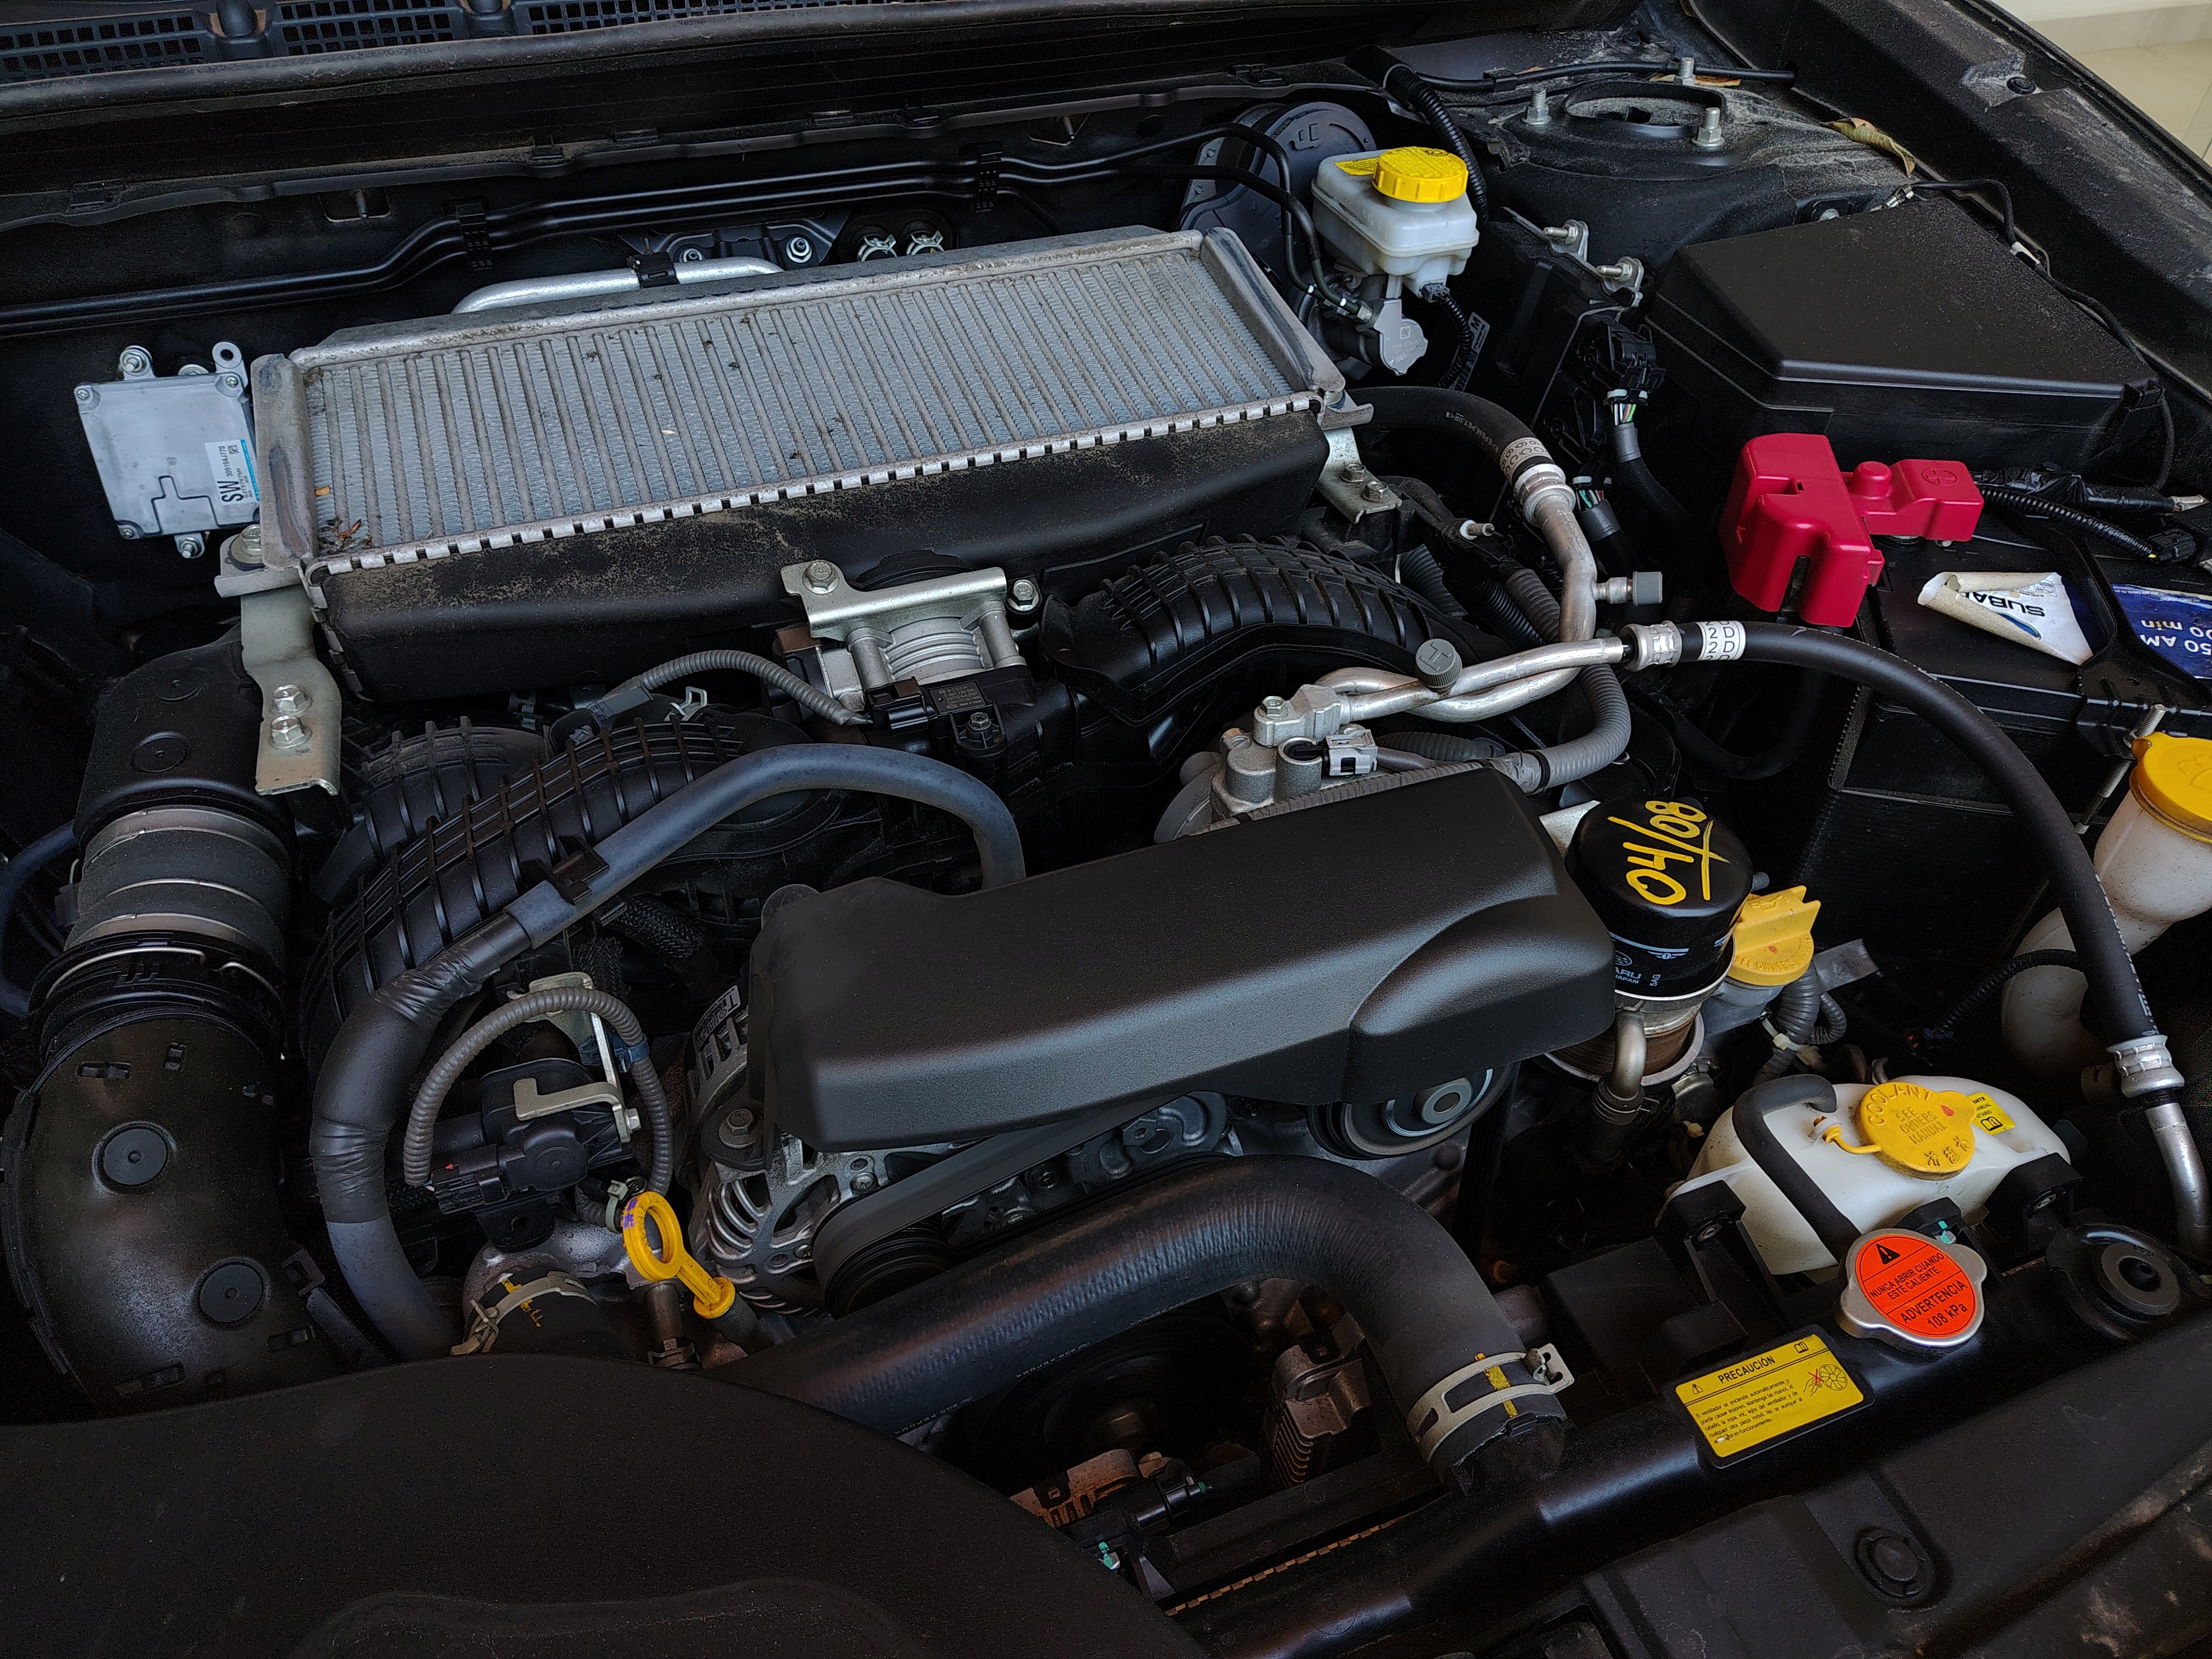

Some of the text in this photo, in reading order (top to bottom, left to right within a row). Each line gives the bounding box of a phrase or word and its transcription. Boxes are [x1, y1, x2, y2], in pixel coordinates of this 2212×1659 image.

[217, 481, 244, 502] SW
[2141, 620, 2183, 631] min
[2140, 635, 2177, 647] AM
[1607, 800, 1730, 905] 04/08
[1866, 1084, 1935, 1124] COOLANT
[1896, 1107, 1918, 1122] SEE
[1908, 1121, 1947, 1144] MANUAL
[1870, 1251, 1944, 1298] NUNCA ABRIR CUANDO
[1900, 1280, 1967, 1324] ADVERTENCIA
[1927, 1300, 1968, 1328] 108 kPa
[1717, 1354, 1775, 1384] PRECAUCIÓN
[1700, 1403, 1722, 1417] ventilador
[1729, 1393, 1749, 1406] enciende
[1700, 1415, 1715, 1426] puede
[1714, 1410, 1728, 1420] causar
[1745, 1394, 1768, 1408] Mantenga
[1766, 1394, 1787, 1407] ventilador
[1709, 1426, 1729, 1439] cualquier
[1739, 1417, 1752, 1427] pieza
